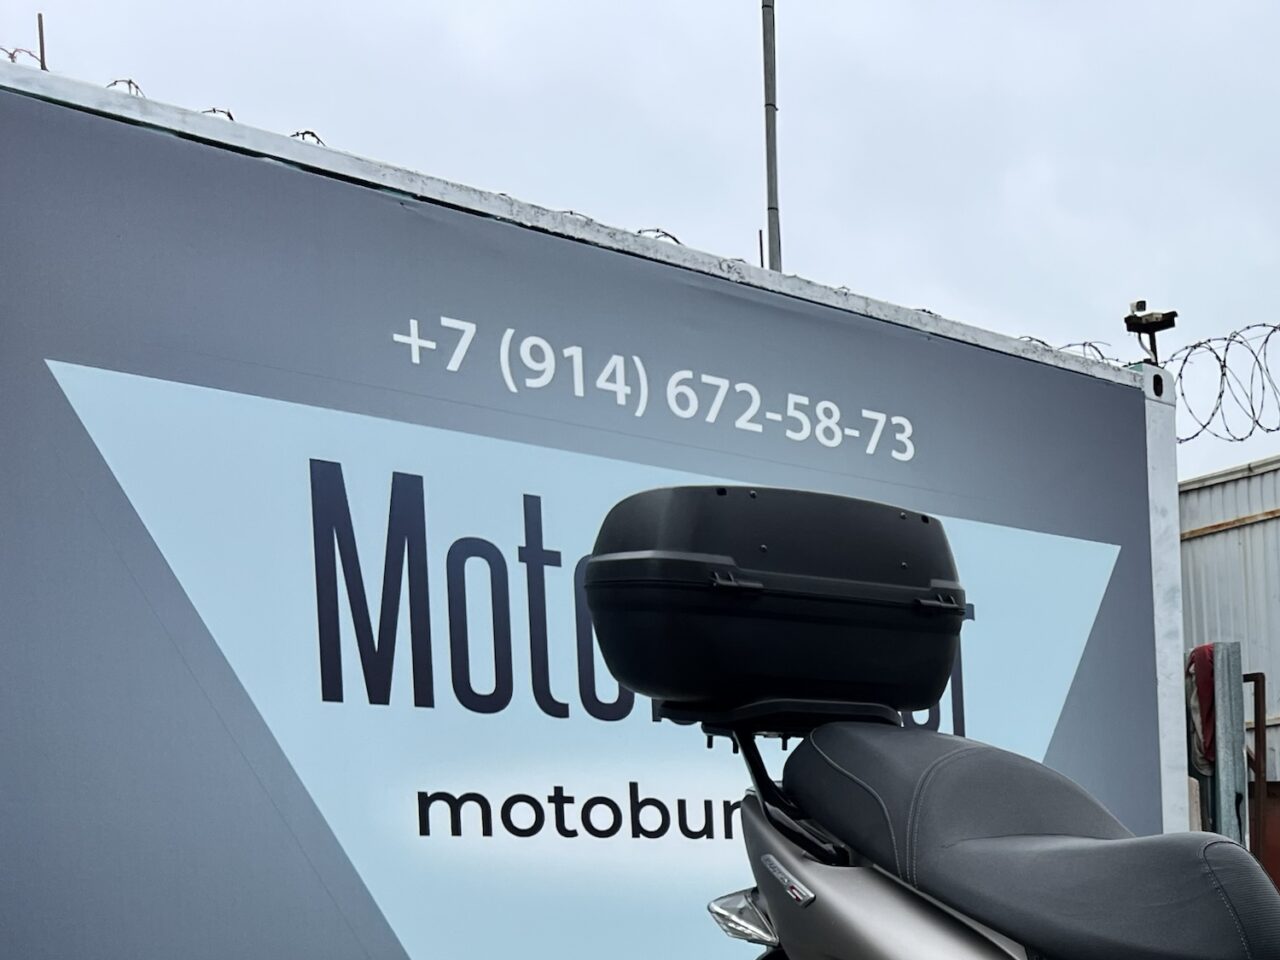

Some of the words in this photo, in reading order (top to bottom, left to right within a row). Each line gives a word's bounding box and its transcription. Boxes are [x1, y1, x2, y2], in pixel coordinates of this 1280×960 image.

[392, 315, 477, 372] +7
[499, 327, 650, 418] (914)
[665, 369, 916, 462] 672-58-73
